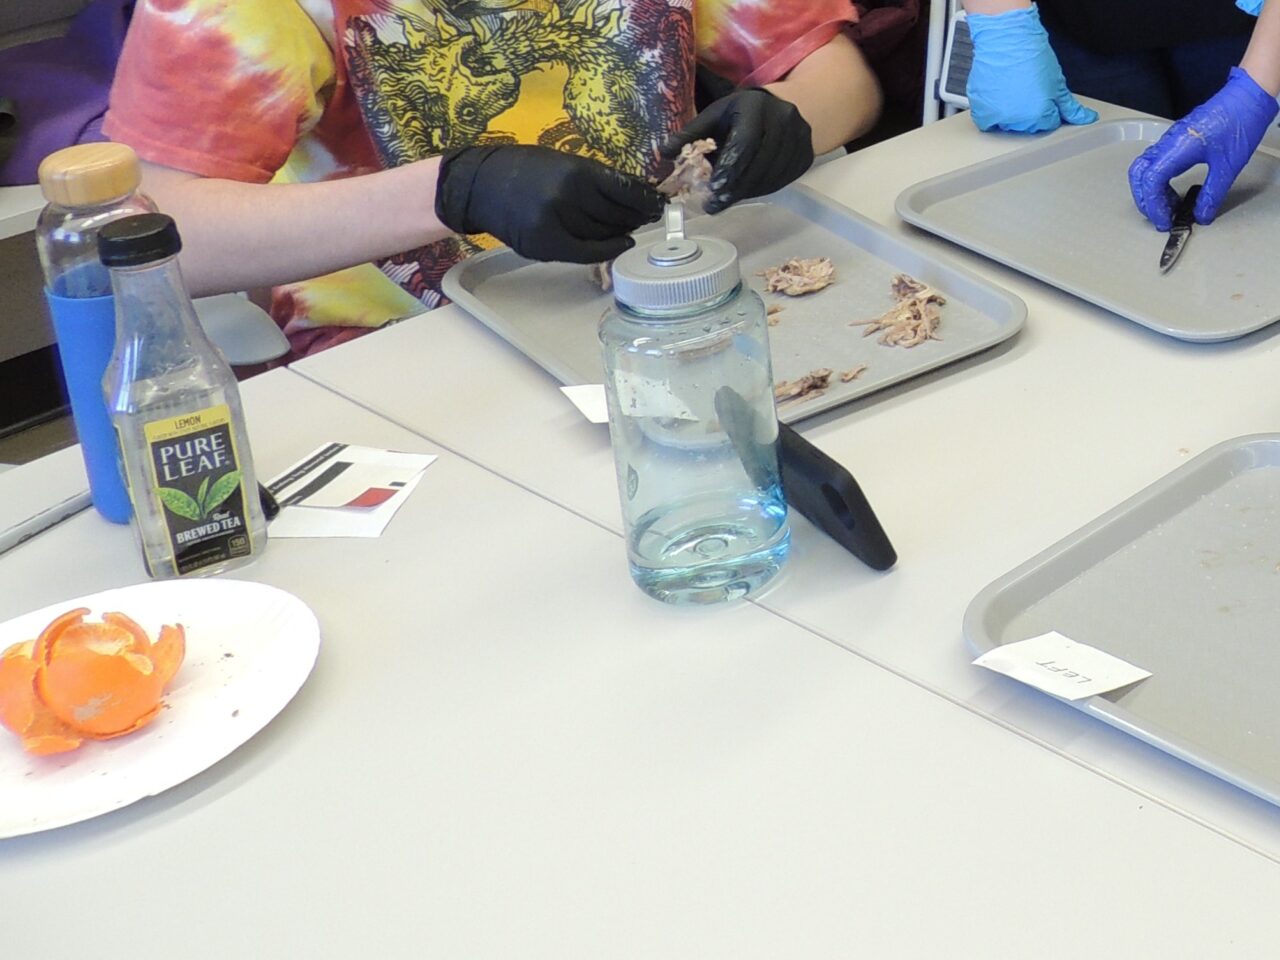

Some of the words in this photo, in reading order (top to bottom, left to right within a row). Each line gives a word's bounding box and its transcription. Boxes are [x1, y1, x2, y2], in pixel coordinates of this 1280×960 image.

[175, 415, 202, 429] LEMON
[160, 432, 225, 464] PURE
[163, 450, 227, 482] LEAF
[176, 521, 220, 544] BREWED
[221, 516, 241, 530] TEA
[1034, 660, 1092, 684] LEFT
